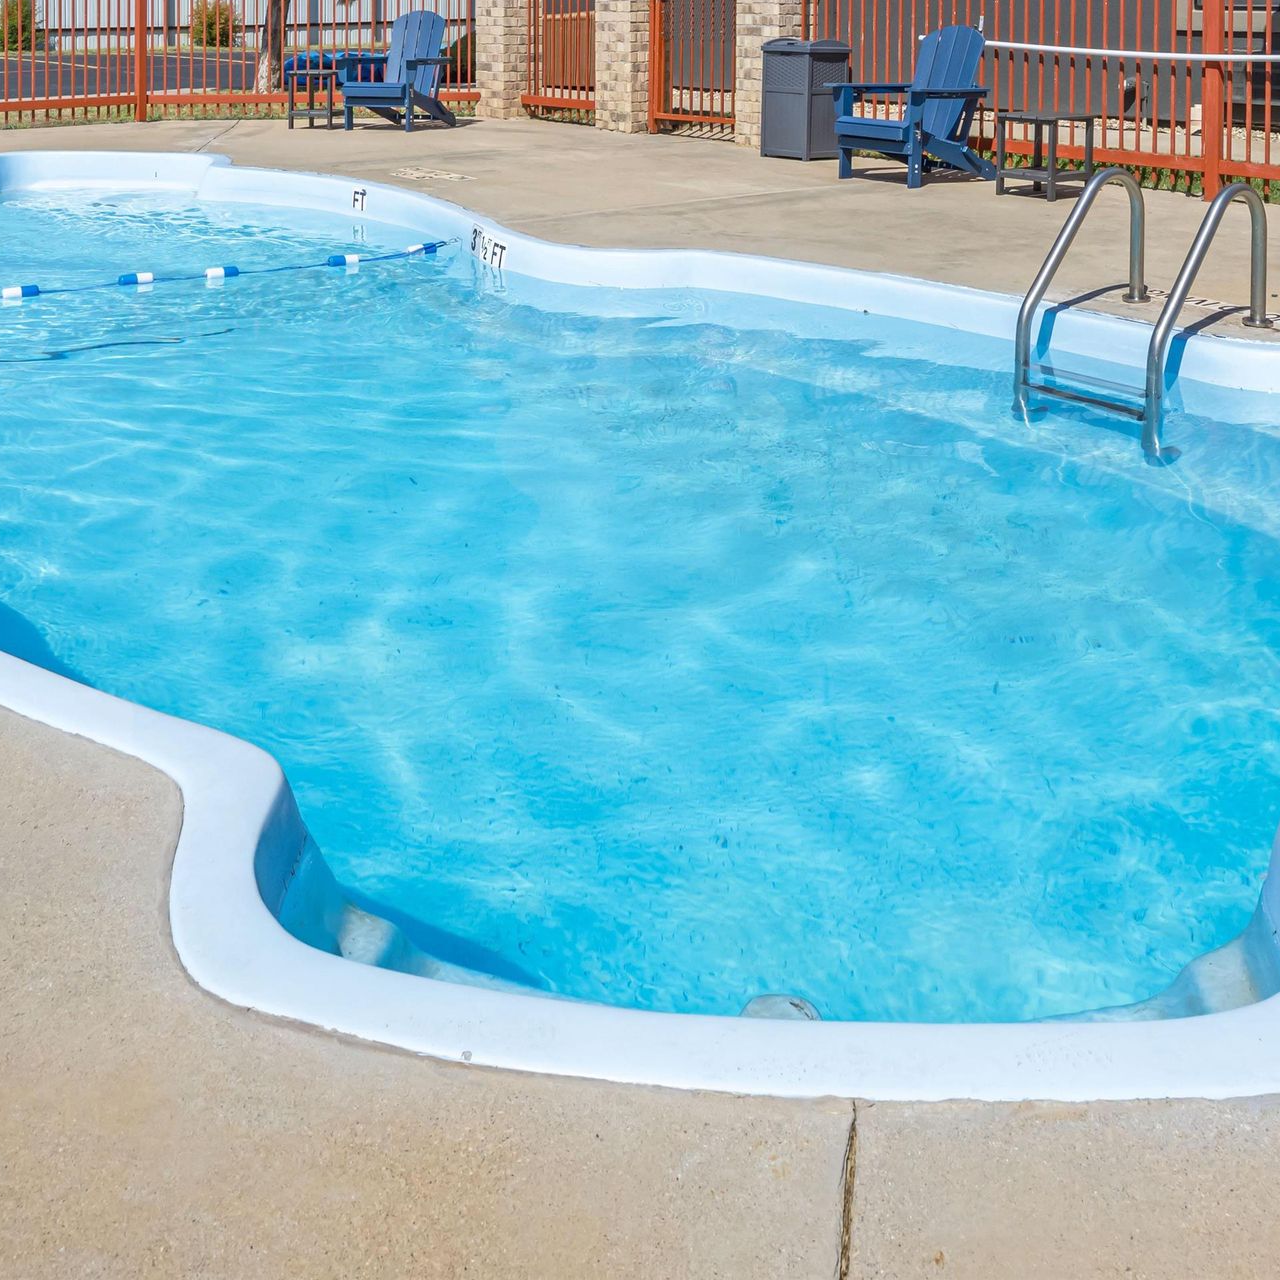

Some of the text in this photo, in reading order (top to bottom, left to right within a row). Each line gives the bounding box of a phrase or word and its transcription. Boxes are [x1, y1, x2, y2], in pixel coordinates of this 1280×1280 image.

[352, 189, 367, 211] FT
[470, 228, 478, 251] 3
[490, 242, 507, 269] FT
